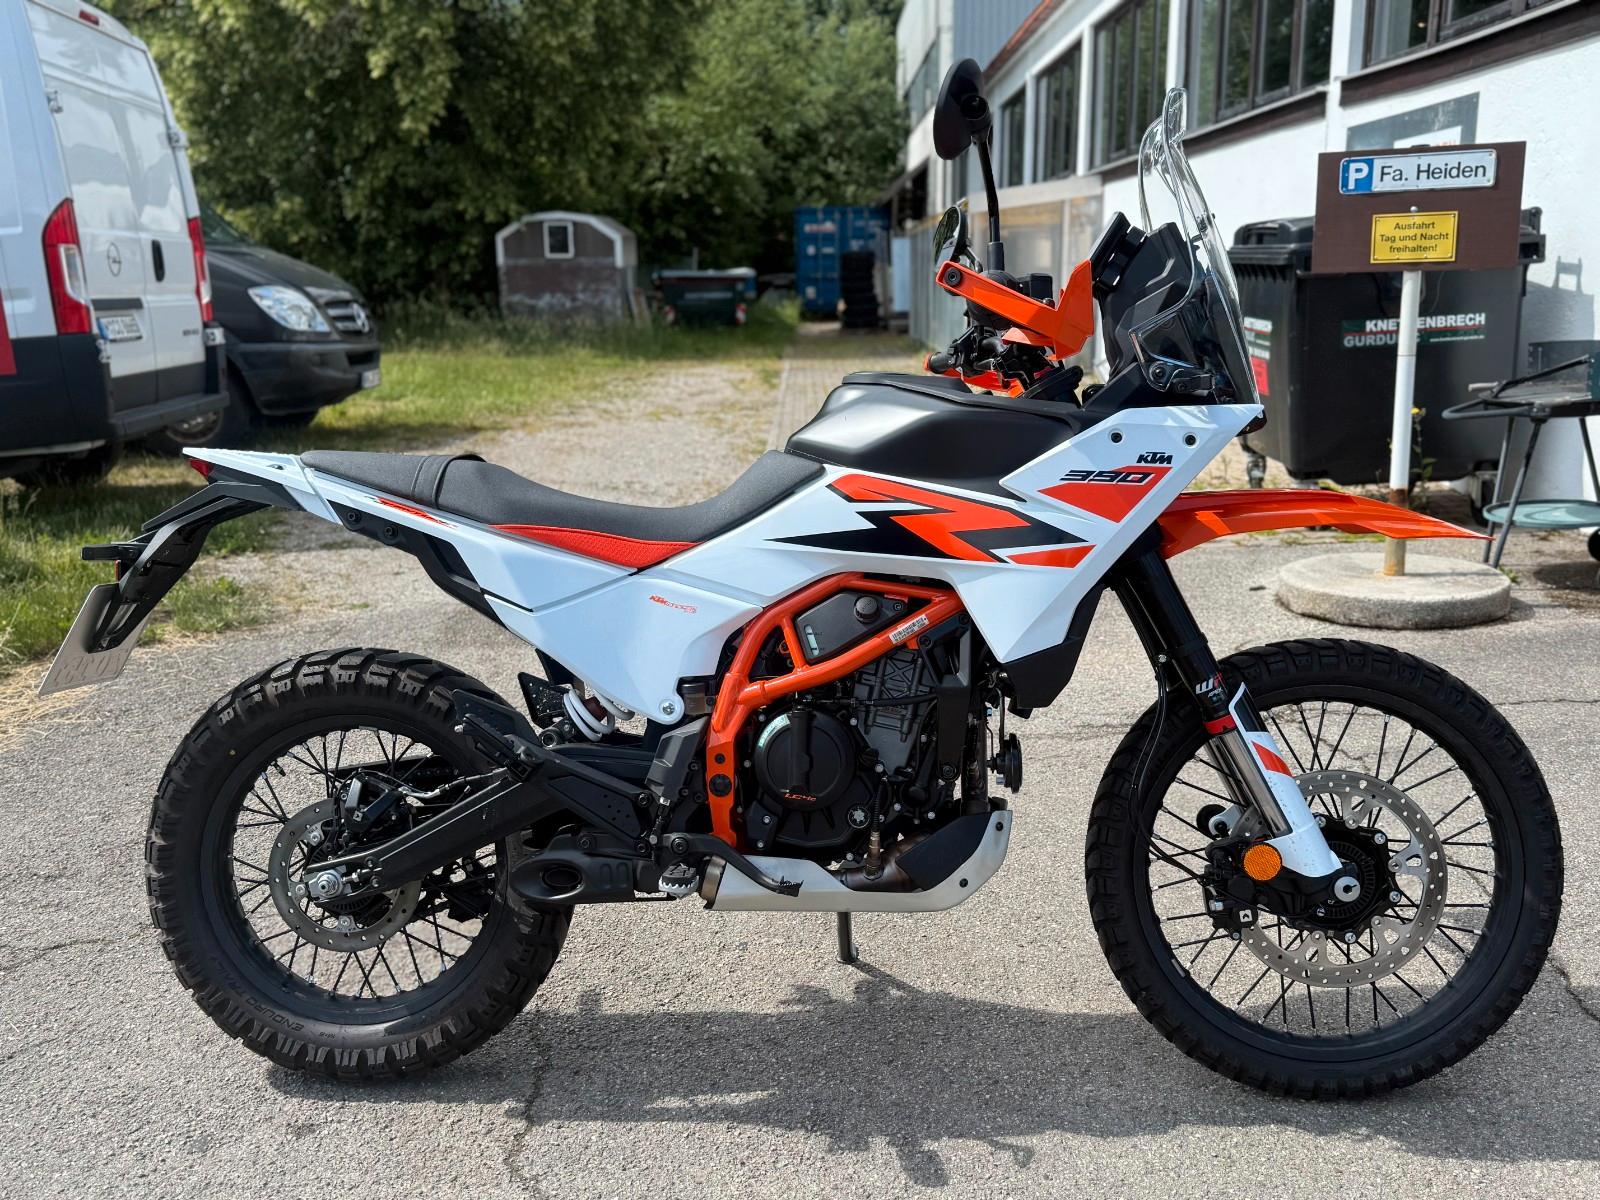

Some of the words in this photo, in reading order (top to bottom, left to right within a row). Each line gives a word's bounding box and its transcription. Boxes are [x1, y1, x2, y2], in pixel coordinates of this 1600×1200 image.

[1347, 162, 1369, 190] P
[1380, 165, 1409, 182] Fa.
[1415, 161, 1487, 181] Heiden
[1393, 221, 1436, 231] Ausfahrt
[1379, 234, 1397, 243] Tag
[1398, 233, 1418, 242] und
[1420, 232, 1450, 241] Nacht
[1388, 243, 1438, 254] freihalten!
[1365, 312, 1486, 333] KNEENBRECH
[1135, 452, 1174, 465] KTM
[1059, 469, 1156, 485] 390
[245, 996, 305, 1032] ENDURO
